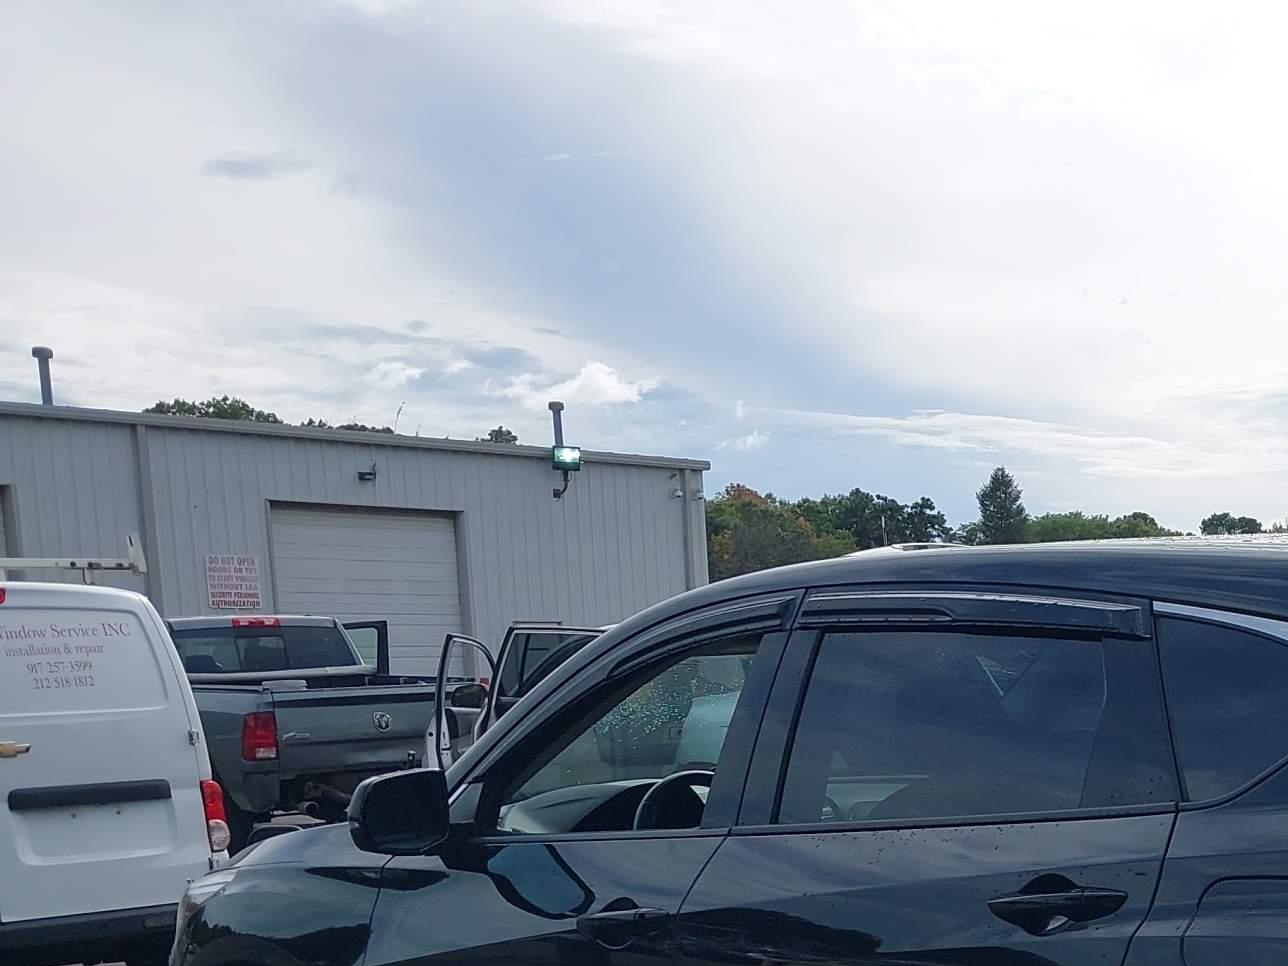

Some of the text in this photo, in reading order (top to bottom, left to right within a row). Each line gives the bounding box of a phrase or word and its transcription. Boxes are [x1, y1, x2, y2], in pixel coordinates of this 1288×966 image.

[209, 556, 256, 566] DO NOT OPEN
[211, 600, 260, 608] AUTHORIZATION
[49, 623, 98, 638] Service
[100, 622, 131, 637] INC
[4, 642, 104, 657] installation & repair
